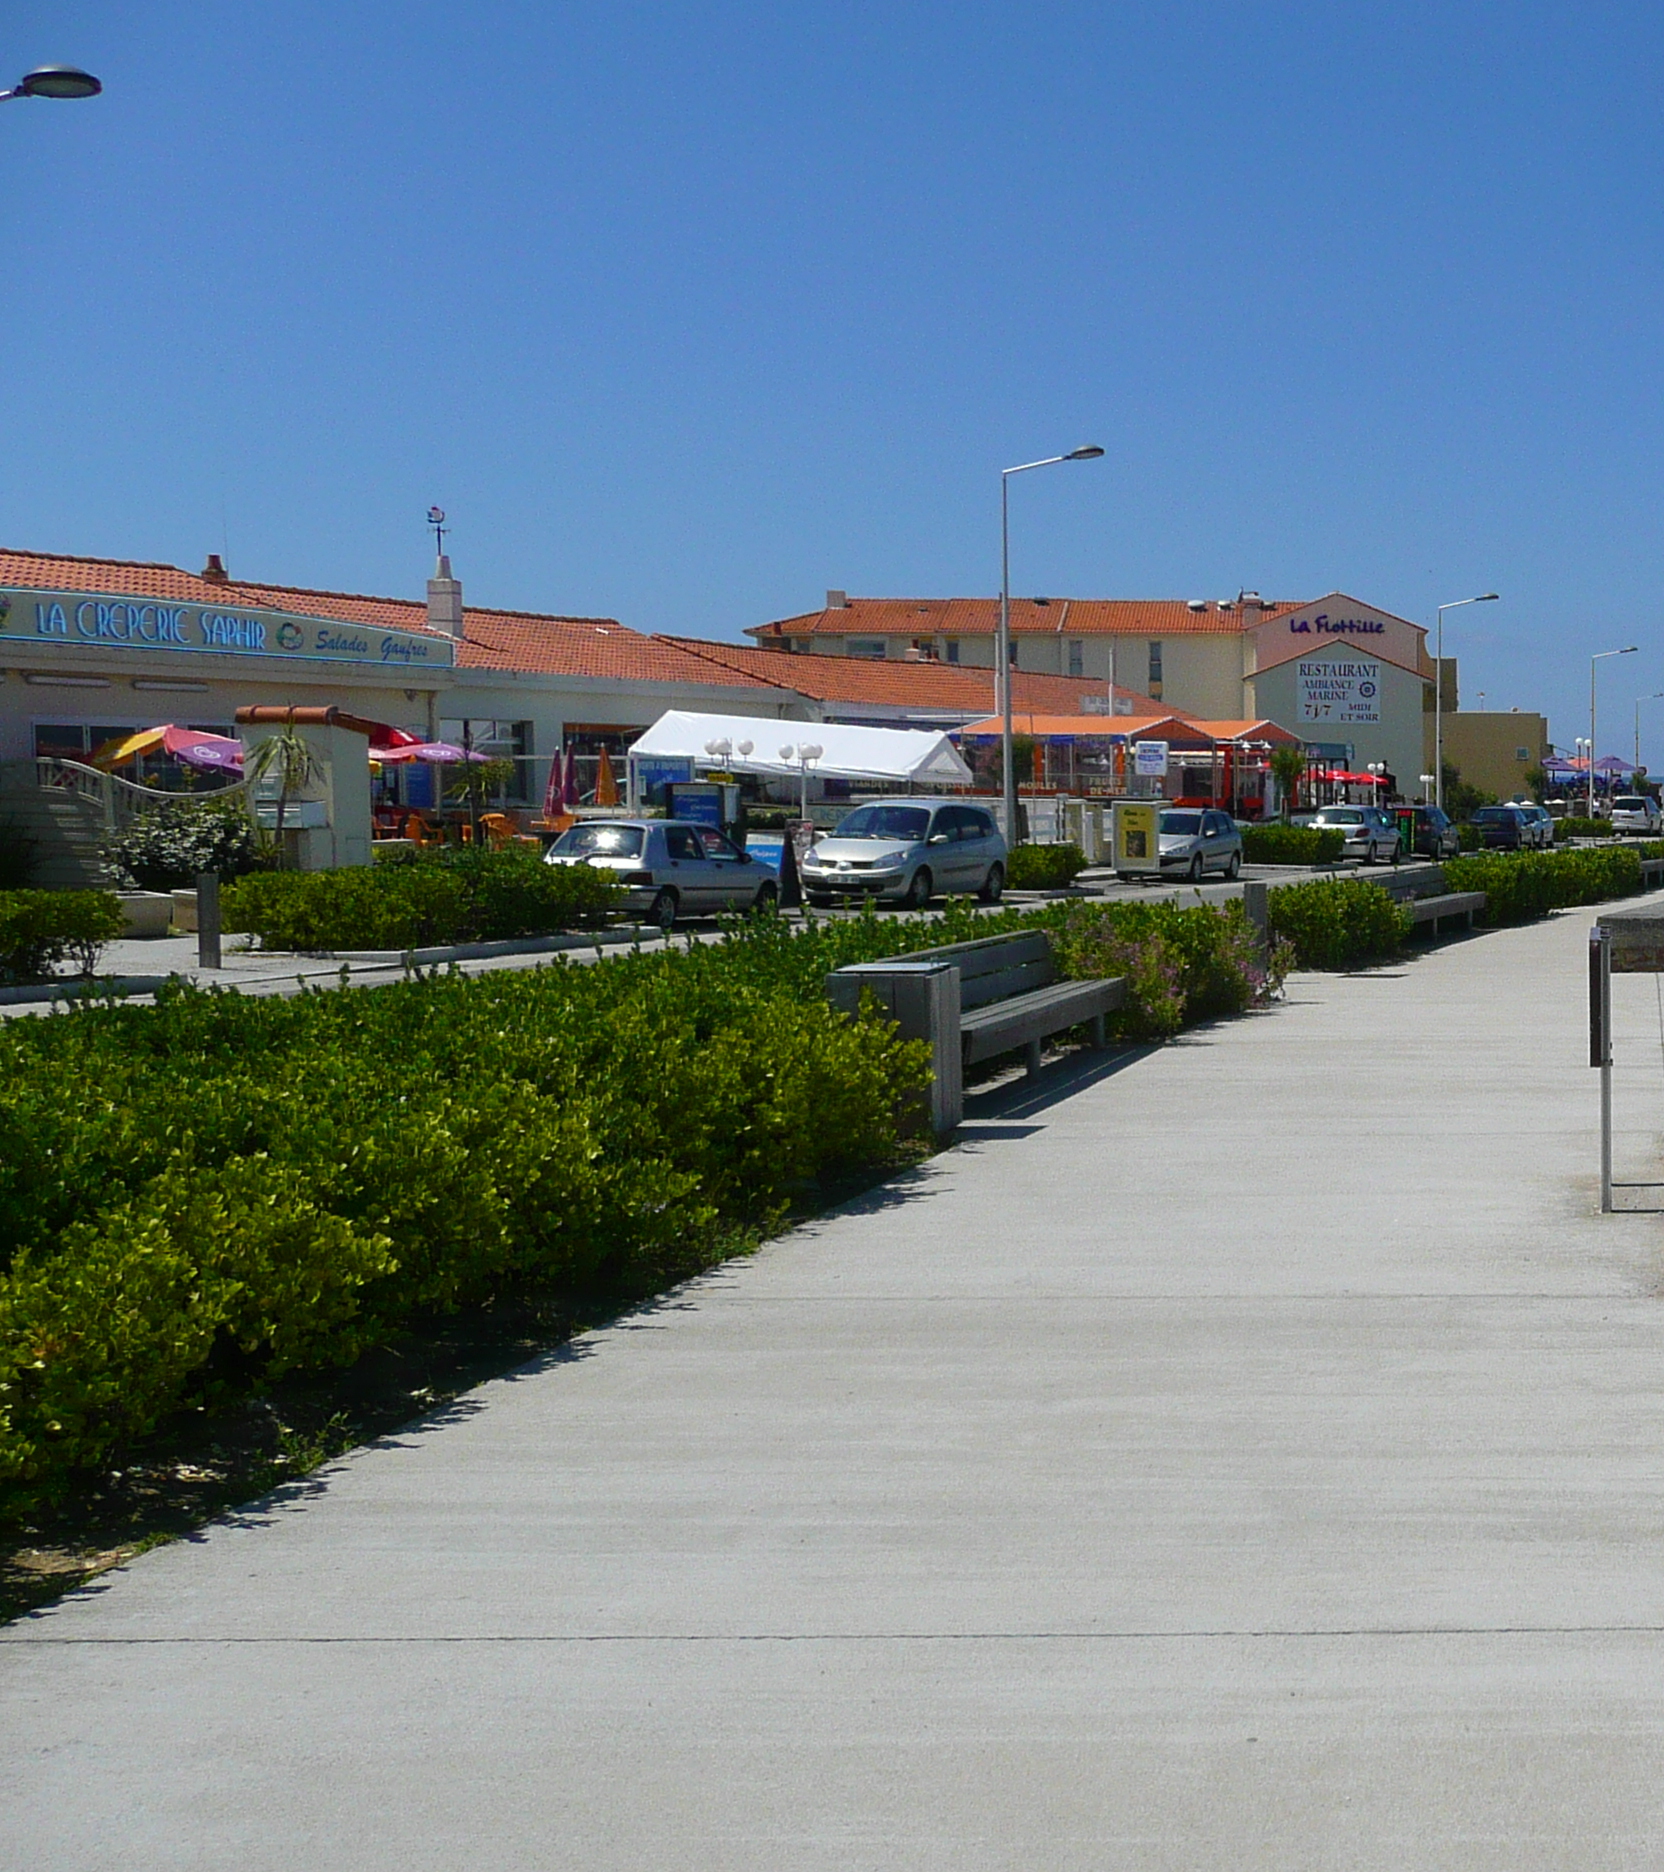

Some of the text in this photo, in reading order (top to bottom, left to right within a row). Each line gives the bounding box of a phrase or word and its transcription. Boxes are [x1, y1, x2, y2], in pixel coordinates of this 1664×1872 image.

[35, 601, 266, 649] LA CREPERIE SAPHIR
[316, 630, 428, 661] Salades Gaufres
[1299, 663, 1379, 677] RESTAURANT
[1302, 679, 1354, 690] AMBIANCE
[1307, 690, 1350, 701] MARINE
[1348, 703, 1371, 712] MIDI
[1340, 713, 1379, 721] ET SOIR
[1018, 781, 1058, 790] MOULES
